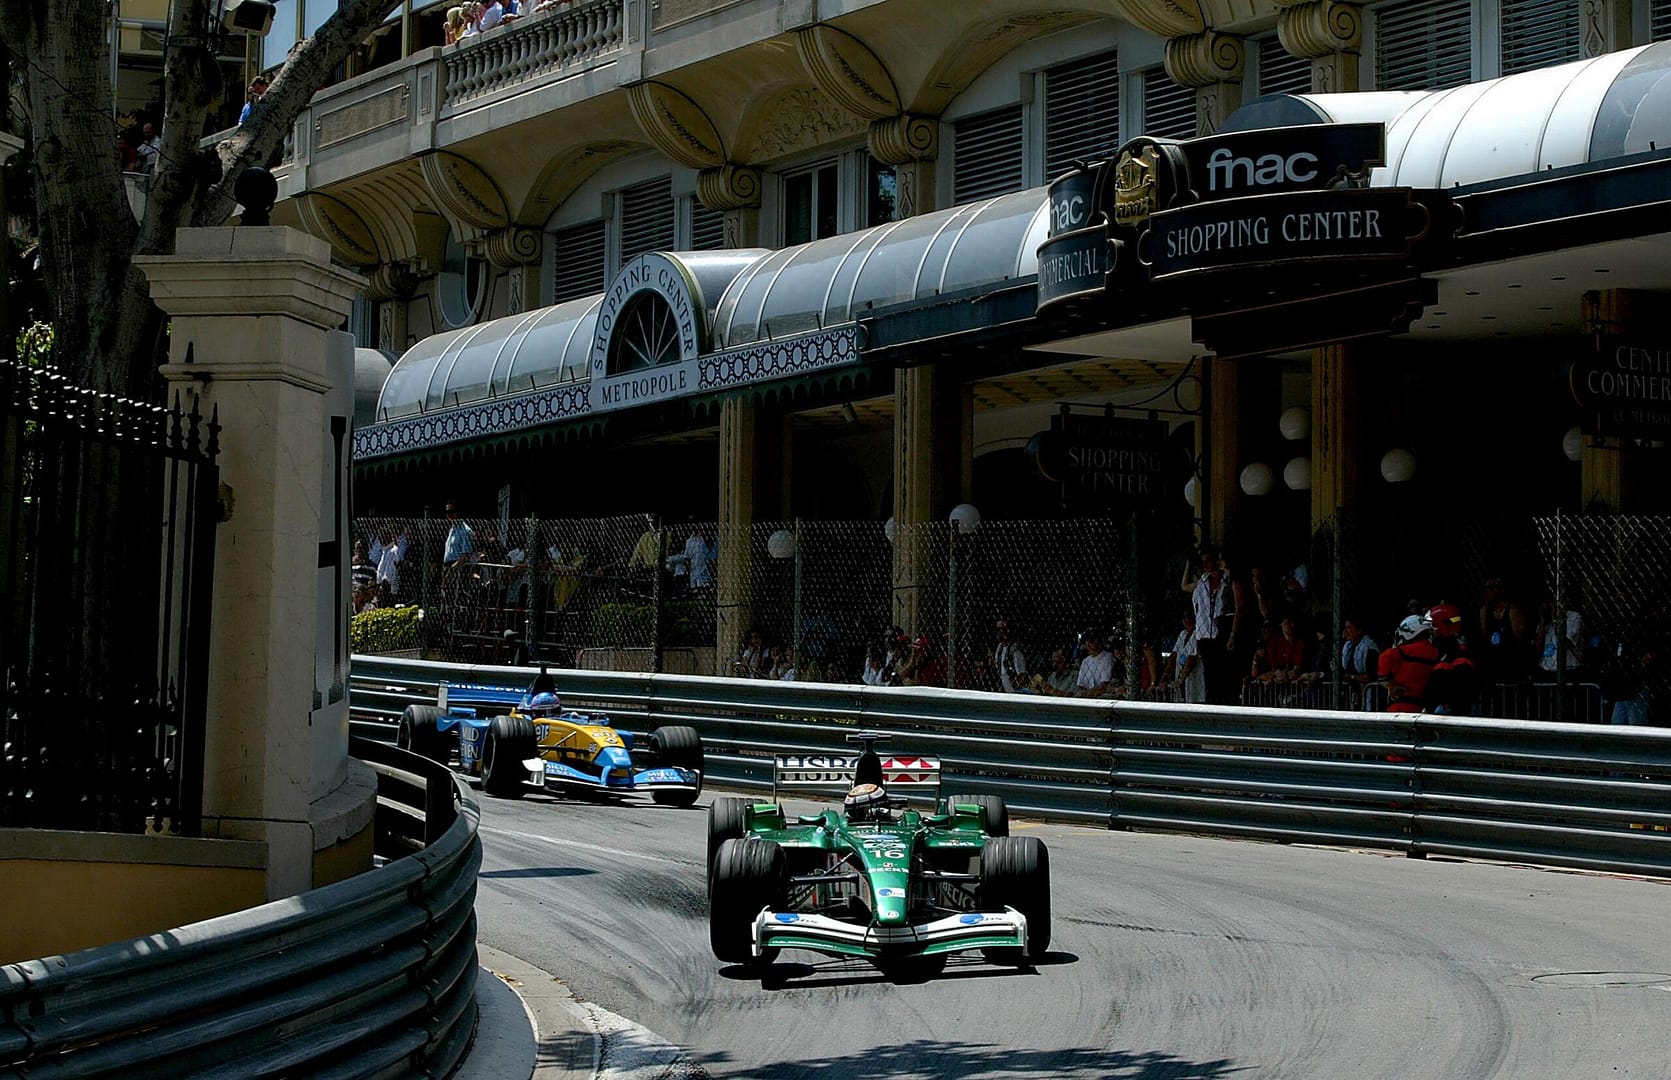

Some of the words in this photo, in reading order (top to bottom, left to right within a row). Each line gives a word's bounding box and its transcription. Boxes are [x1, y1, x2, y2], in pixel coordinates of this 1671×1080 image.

[1206, 148, 1319, 192] fnac
[1166, 216, 1270, 259] SHOPPING
[1281, 209, 1383, 243] CENTER
[595, 265, 651, 370] SHOPPING
[658, 268, 694, 354] CENTER
[602, 370, 687, 405] METROPOLE
[1068, 446, 1161, 473] SHOPPING
[869, 850, 905, 859] 16
